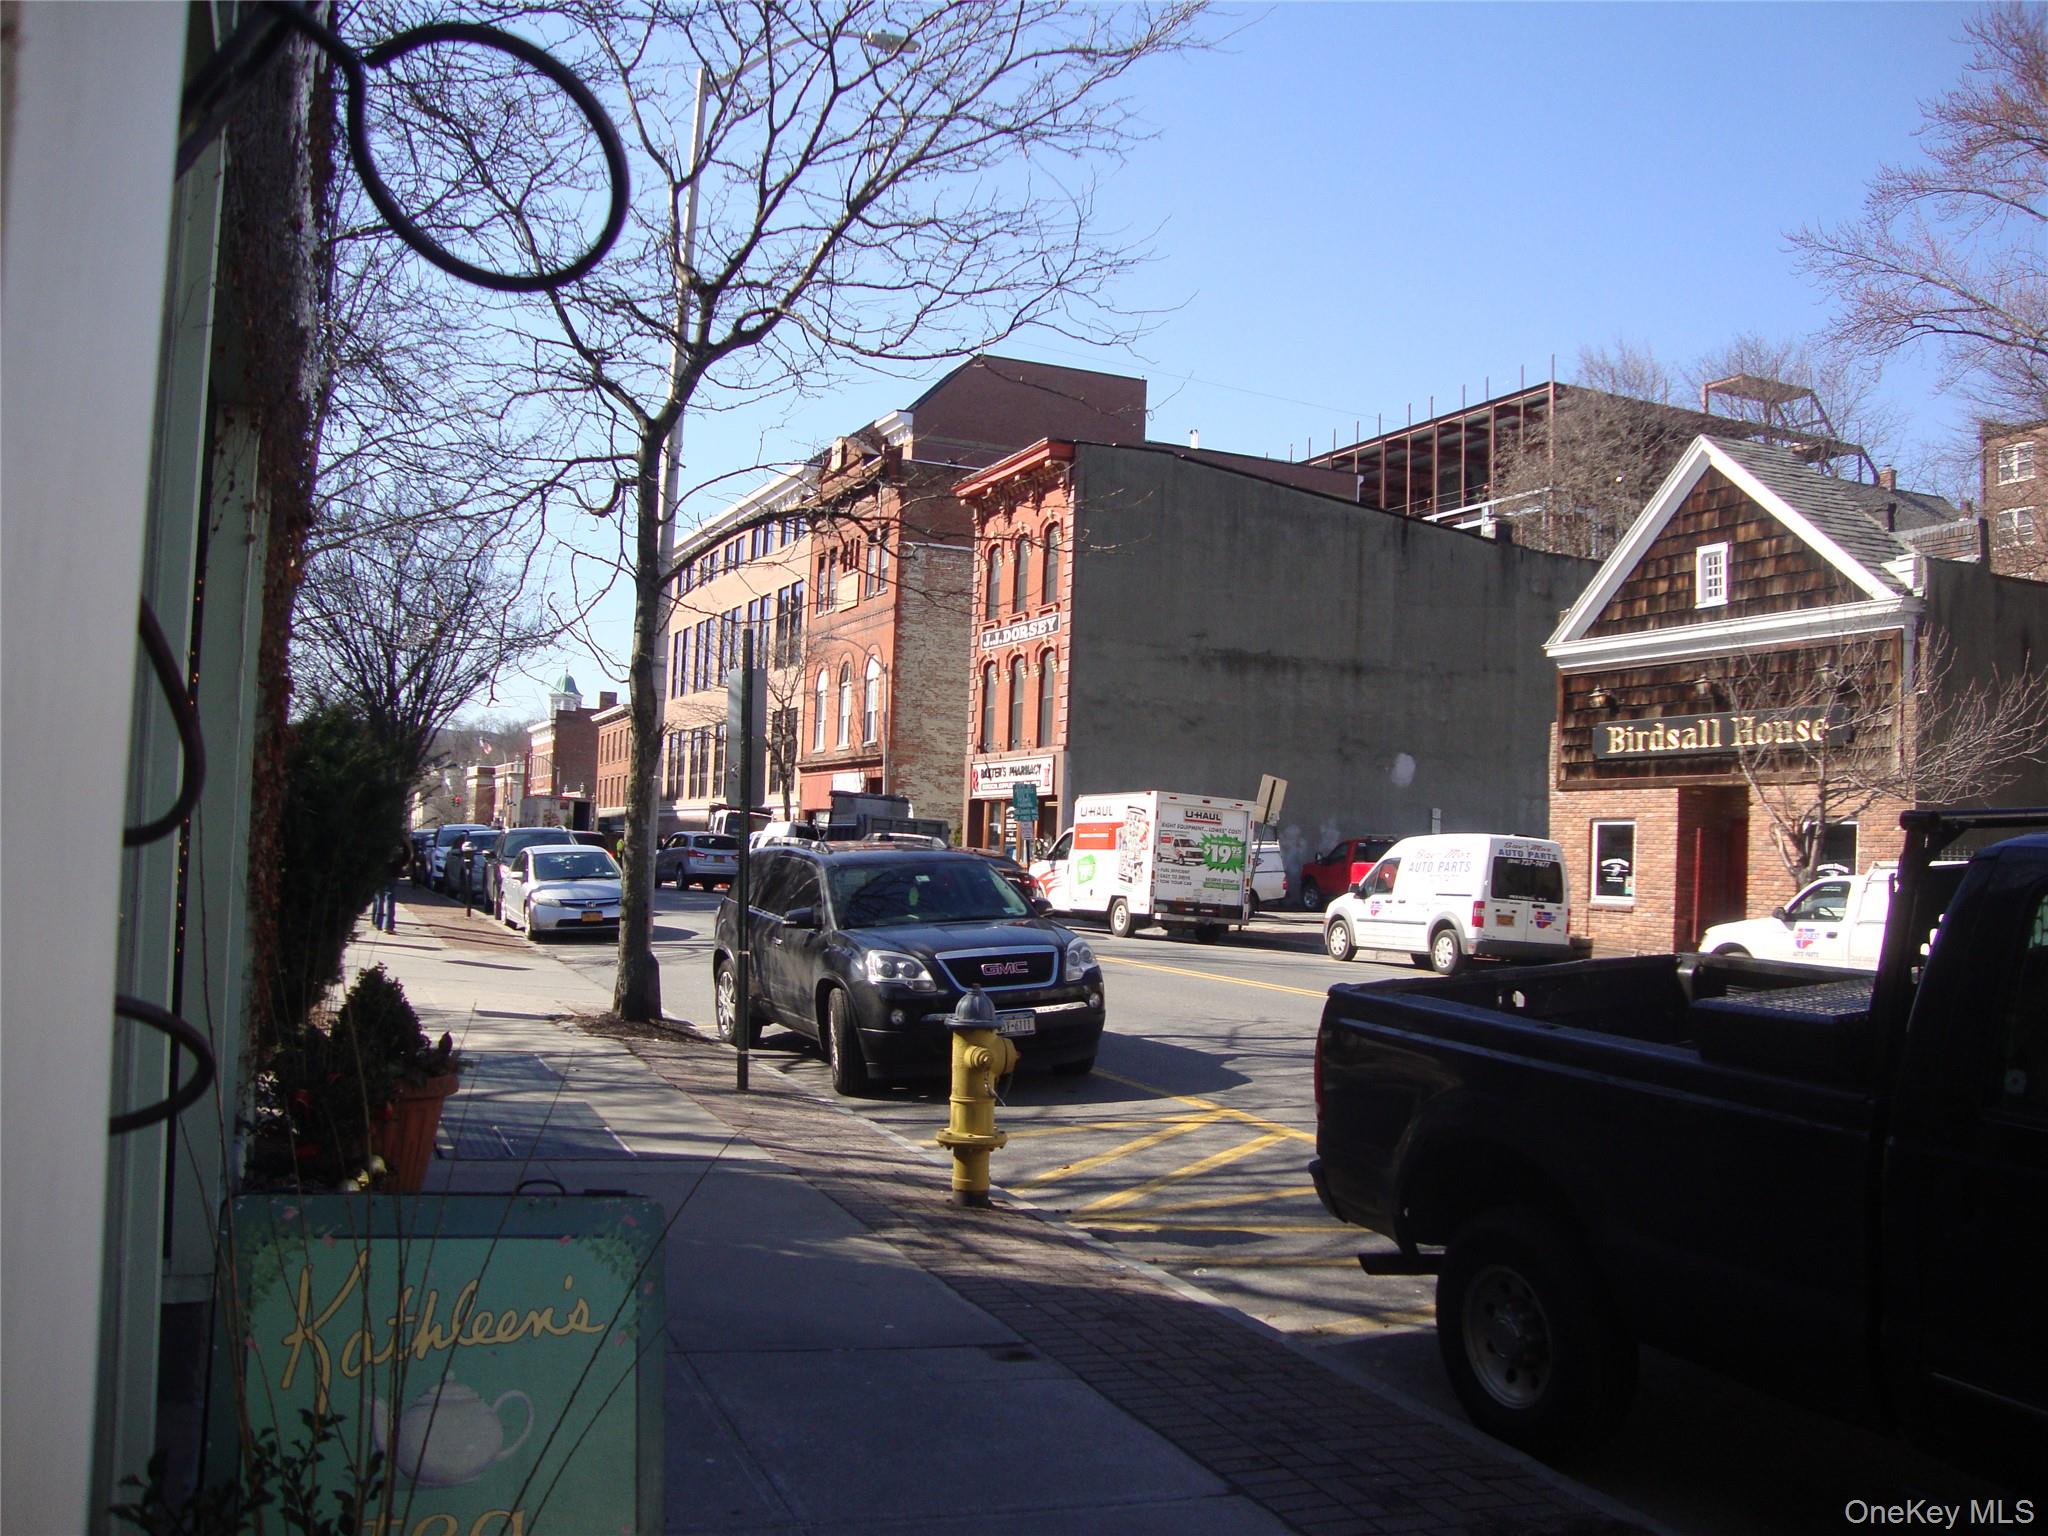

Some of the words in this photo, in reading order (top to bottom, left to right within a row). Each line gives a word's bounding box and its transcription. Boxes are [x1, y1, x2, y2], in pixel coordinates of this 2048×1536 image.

[1606, 718, 1722, 754] Birdsall
[1730, 716, 1829, 747] House
[1008, 763, 1042, 777] PHARMACY
[1185, 810, 1222, 821] U-HAUL
[1498, 848, 1524, 858] AUTO
[1527, 851, 1558, 861] PARTS
[1408, 861, 1434, 873] AUTO
[1437, 861, 1472, 873] PARTS
[980, 961, 1030, 976] GMC
[280, 1248, 605, 1415] Kathleen's
